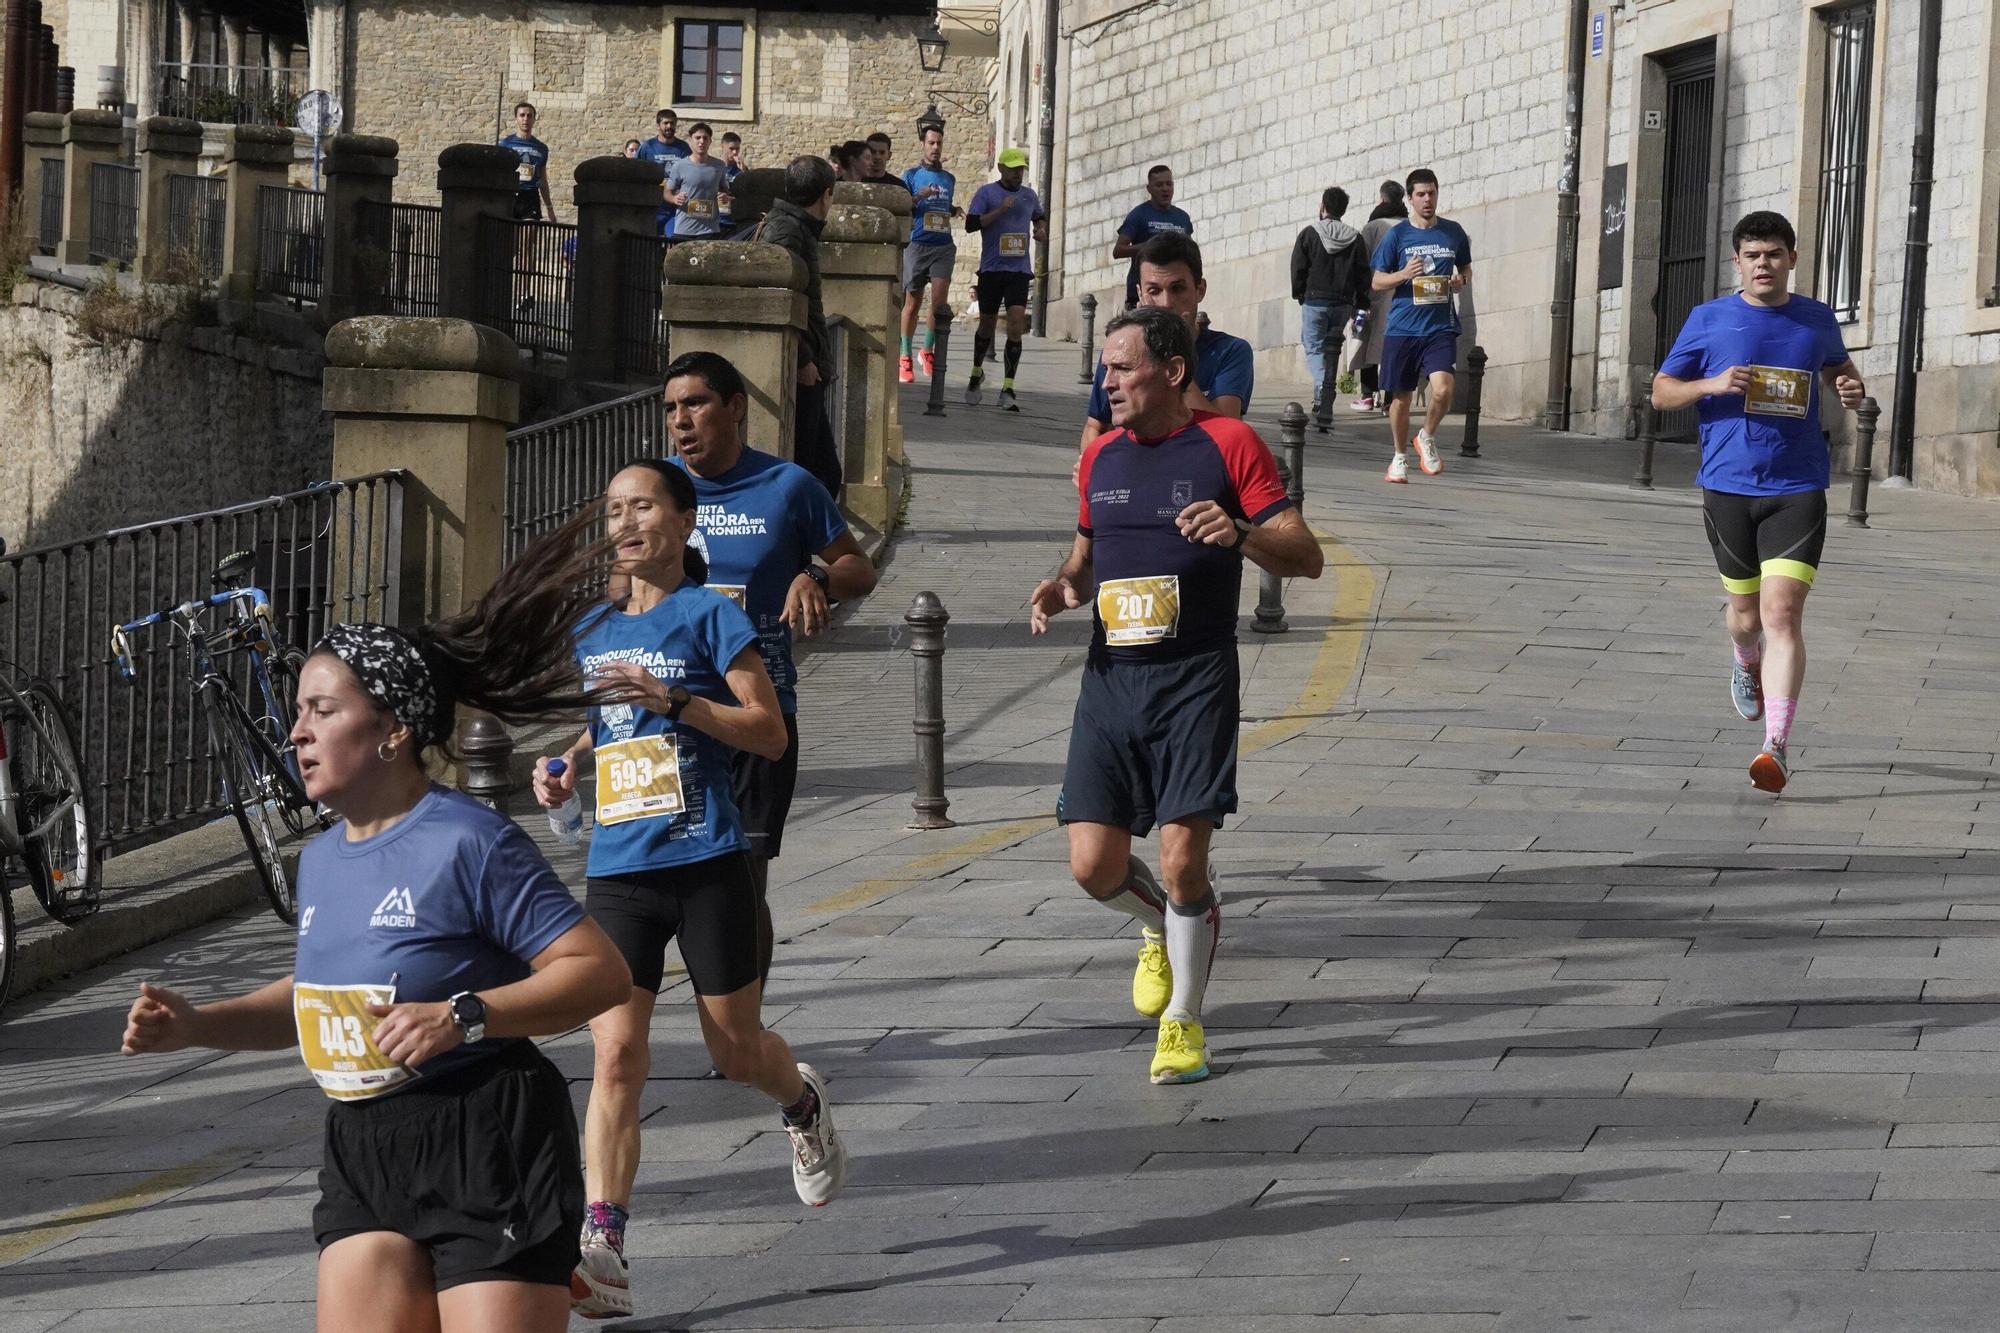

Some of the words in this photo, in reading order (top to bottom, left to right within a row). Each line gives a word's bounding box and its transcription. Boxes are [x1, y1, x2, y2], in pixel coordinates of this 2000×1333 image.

[1423, 282, 1441, 294] 582
[1766, 379, 1797, 398] 567
[696, 514, 749, 527] ENDRA
[707, 525, 767, 535] KONKISTA
[1116, 593, 1153, 620] 207
[584, 647, 645, 665] CONQUISTA
[667, 659, 686, 667] REN
[648, 665, 686, 679] KISTA
[657, 742, 672, 751] 10K
[610, 757, 653, 792] 593
[369, 915, 416, 928] MADEN
[319, 1015, 367, 1057] 443
